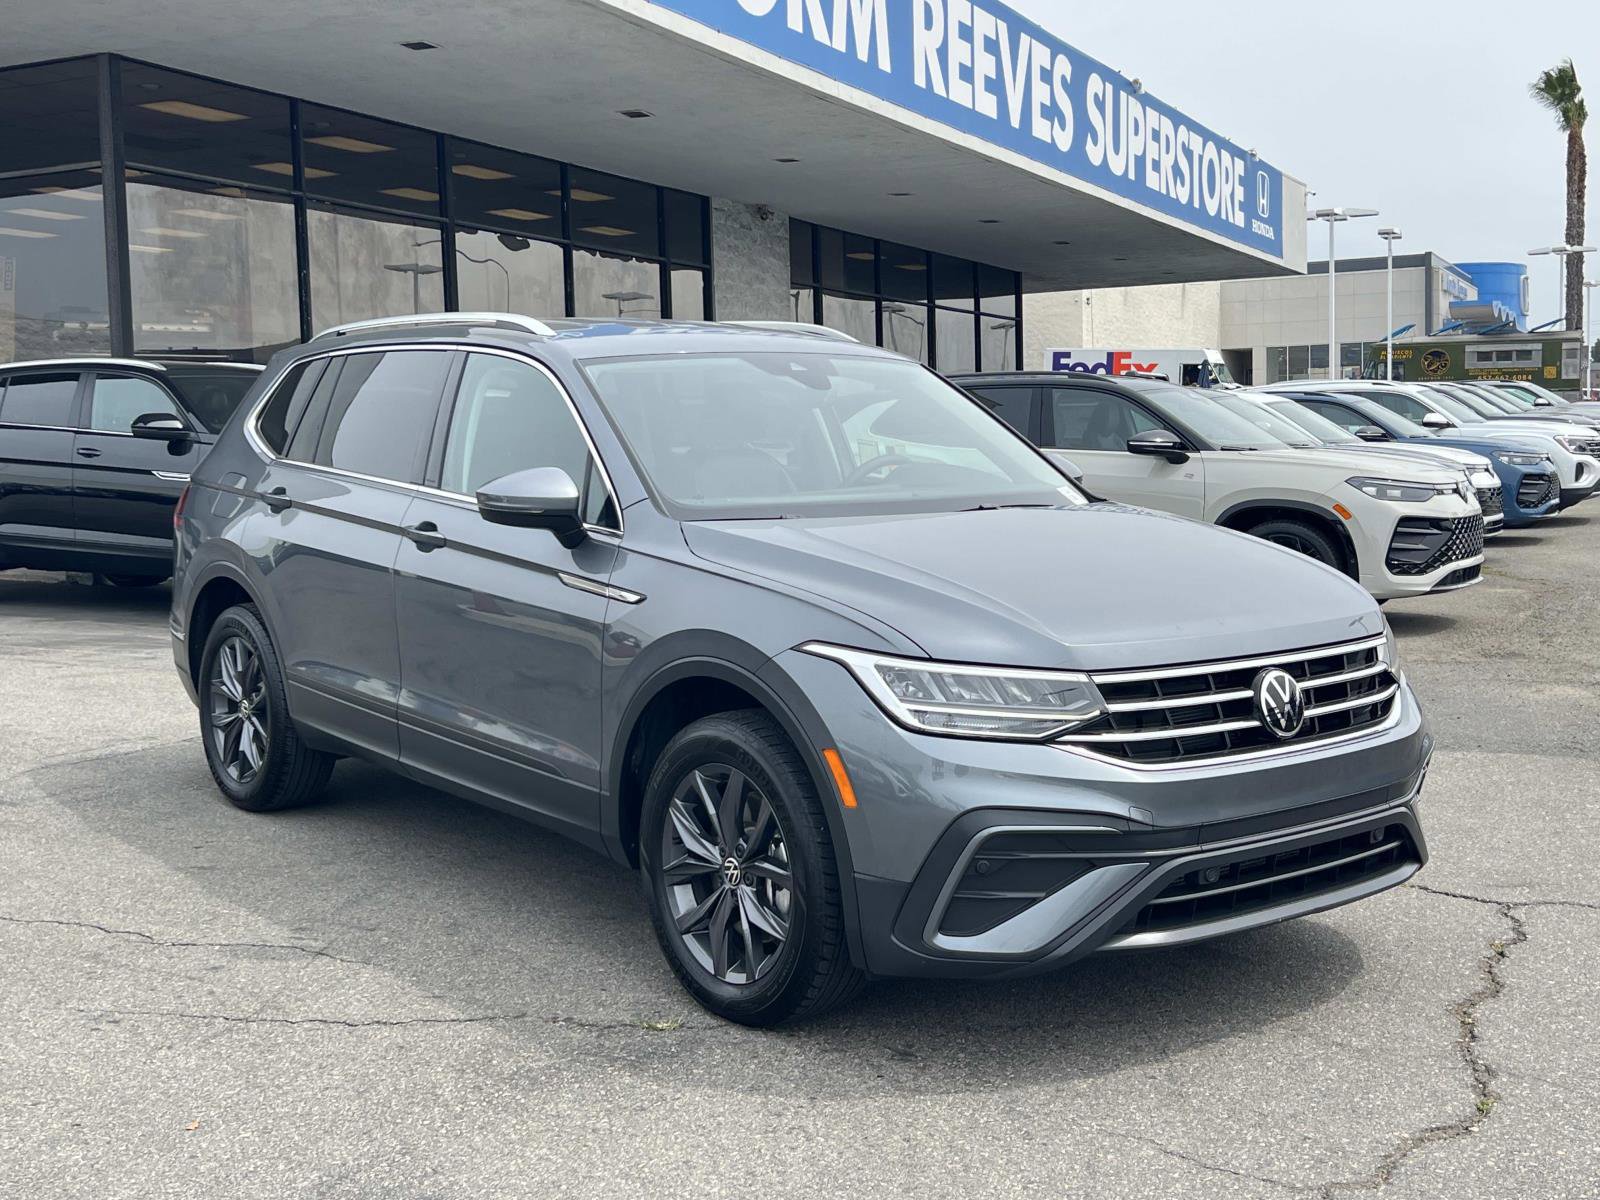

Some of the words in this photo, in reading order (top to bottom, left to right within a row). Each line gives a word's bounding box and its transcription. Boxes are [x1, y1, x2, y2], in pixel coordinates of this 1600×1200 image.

[913, 0, 1073, 152] REEVES
[1085, 73, 1244, 228] SUPERSTORE
[1251, 218, 1275, 240] HONDA
[1052, 352, 1158, 376] FedEx
